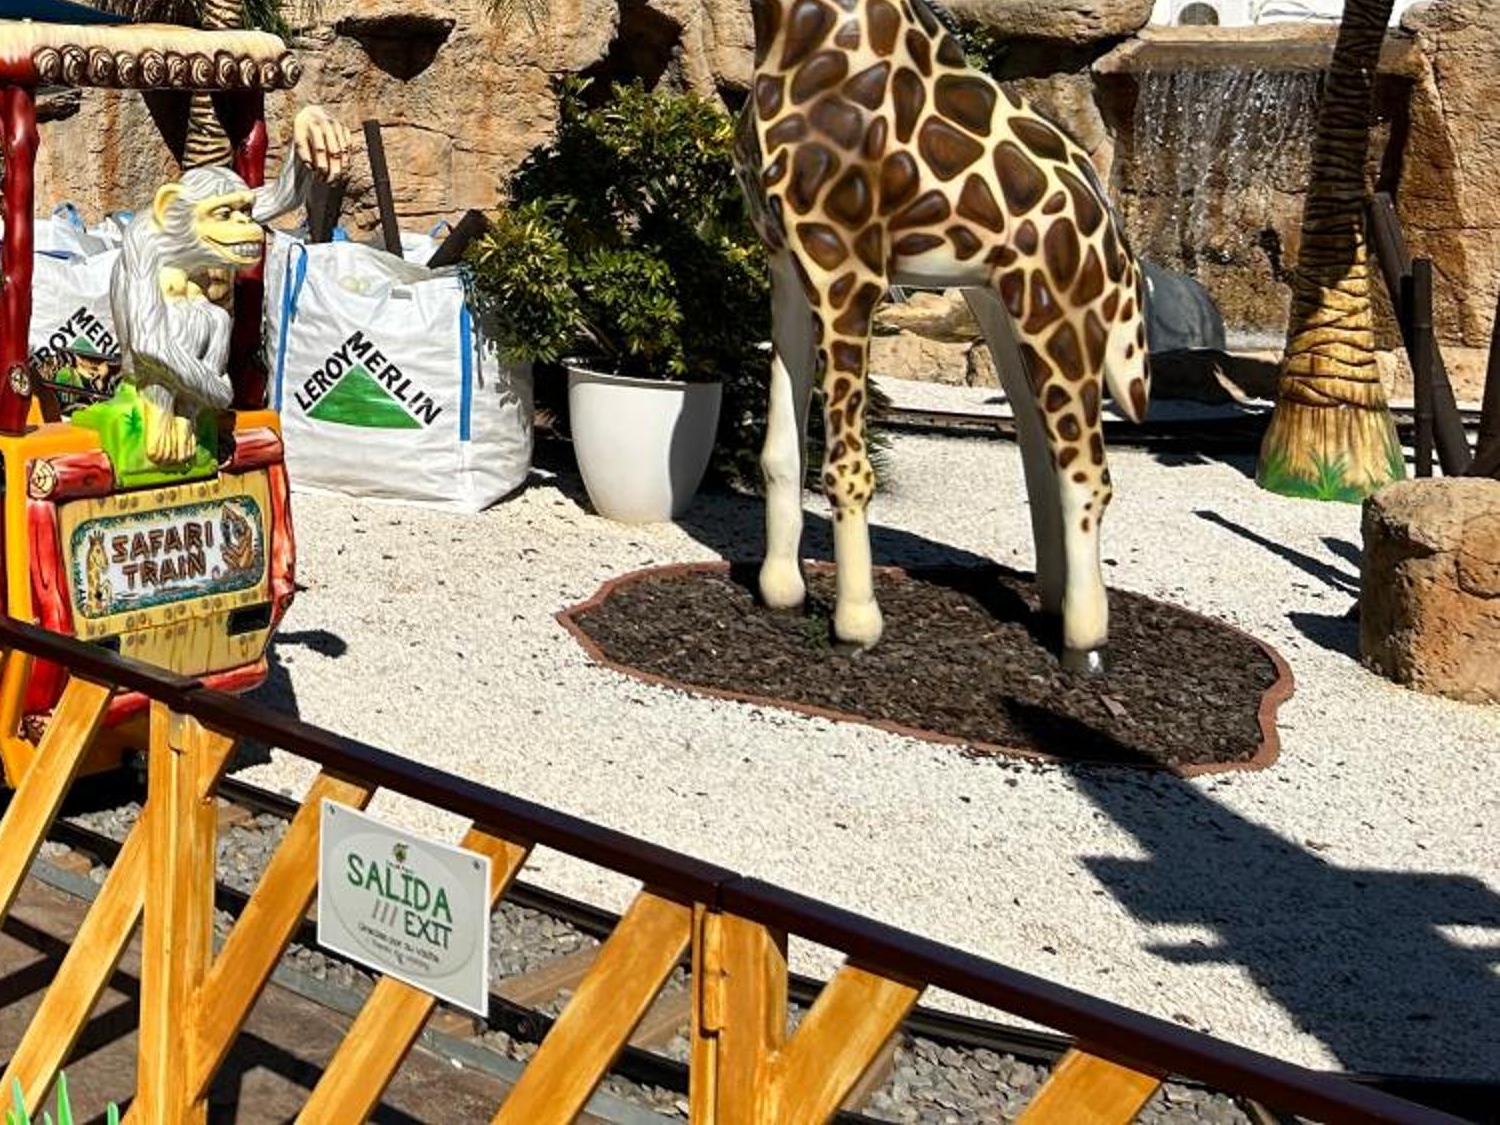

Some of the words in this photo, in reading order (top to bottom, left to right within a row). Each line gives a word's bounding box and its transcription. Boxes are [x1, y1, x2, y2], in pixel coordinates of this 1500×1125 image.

[32, 319, 78, 363] ROY
[70, 306, 120, 356] MERL
[293, 343, 353, 411] LEROY
[346, 330, 443, 426] MERLIN
[111, 520, 214, 565] SAFARI
[121, 549, 207, 591] TRAIN
[347, 852, 453, 924] SALIDA
[404, 909, 453, 951] EXIT
